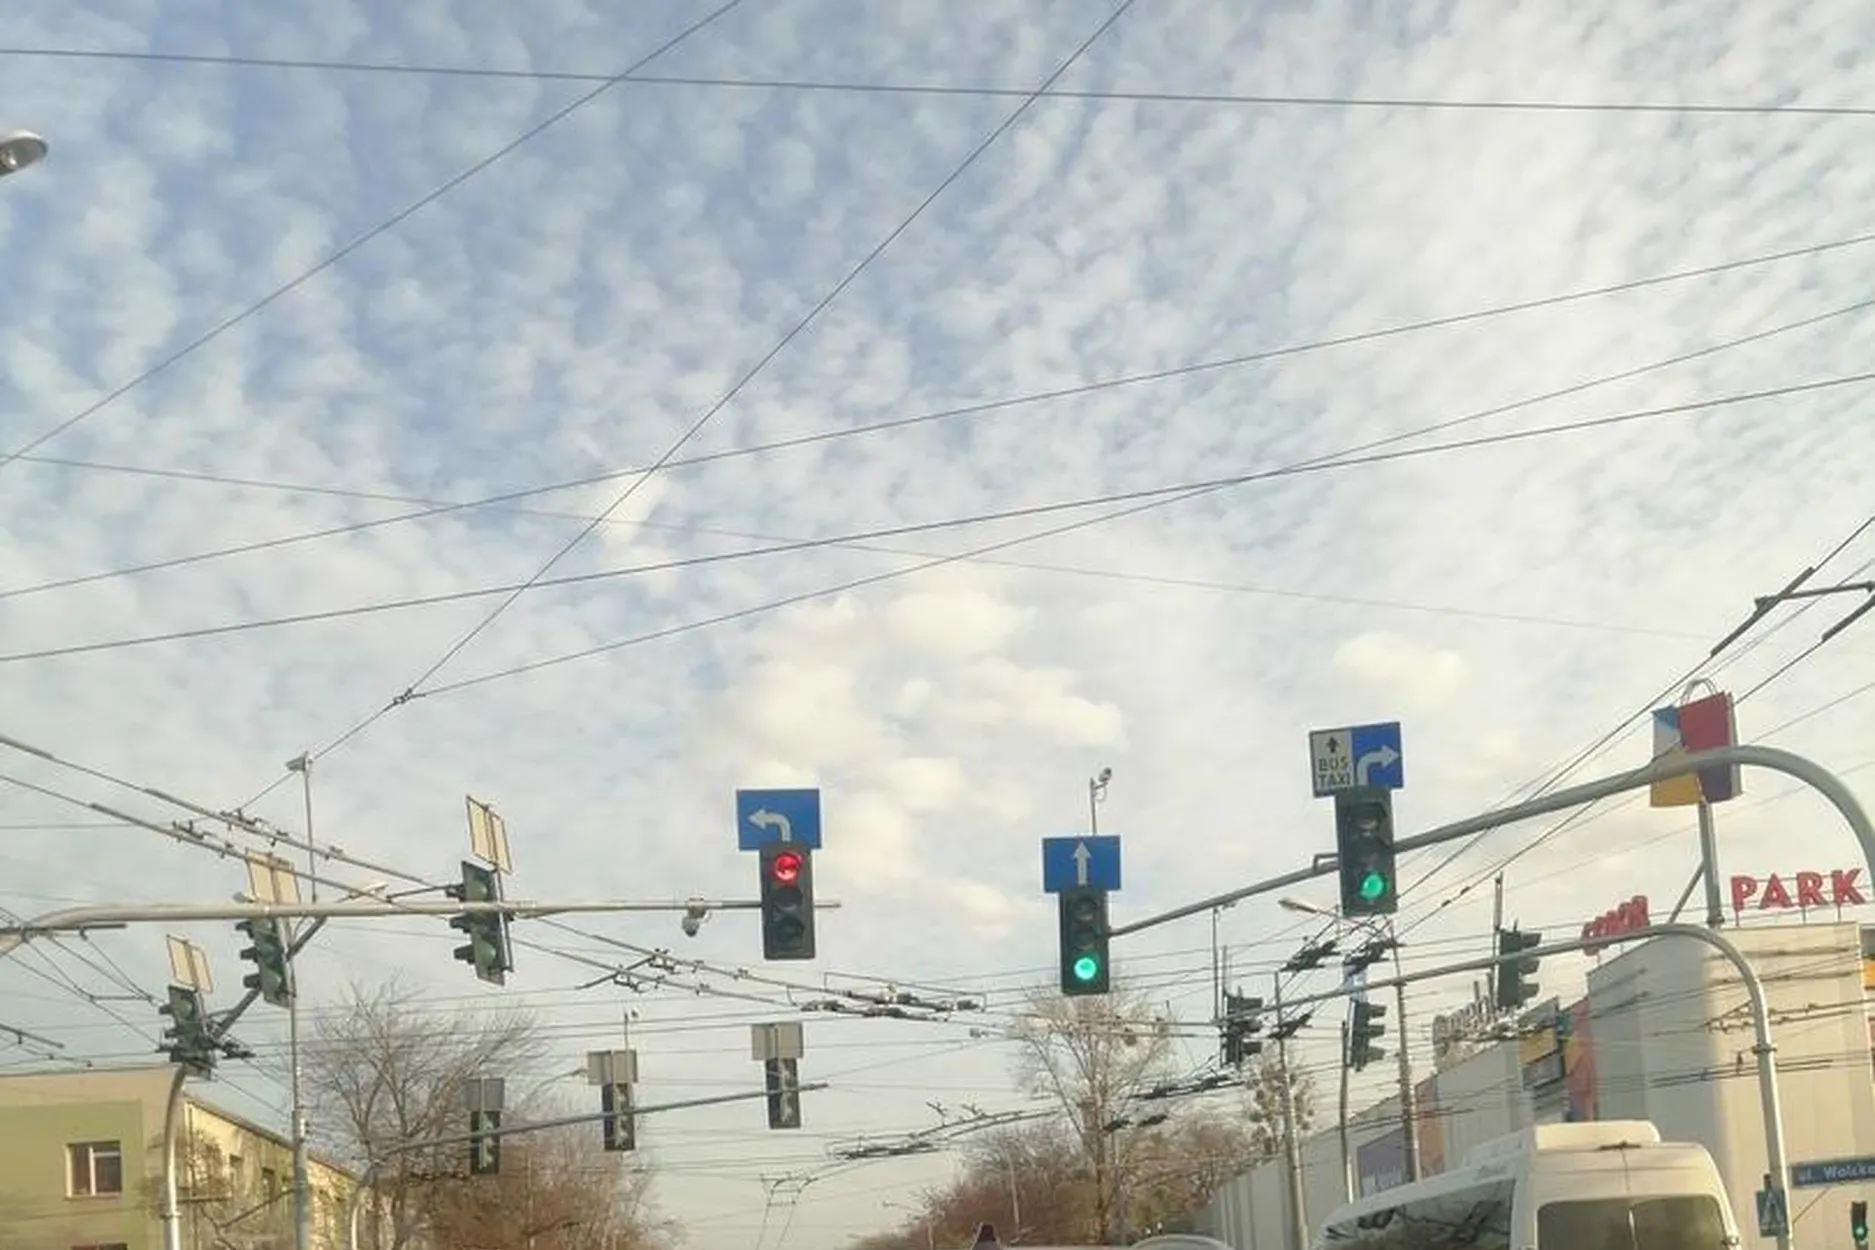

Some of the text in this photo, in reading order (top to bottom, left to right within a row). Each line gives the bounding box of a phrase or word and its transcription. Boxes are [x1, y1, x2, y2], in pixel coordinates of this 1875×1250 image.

[1318, 756, 1349, 771] BUS
[1318, 772, 1351, 788] TAXI
[1730, 868, 1866, 911] PARK
